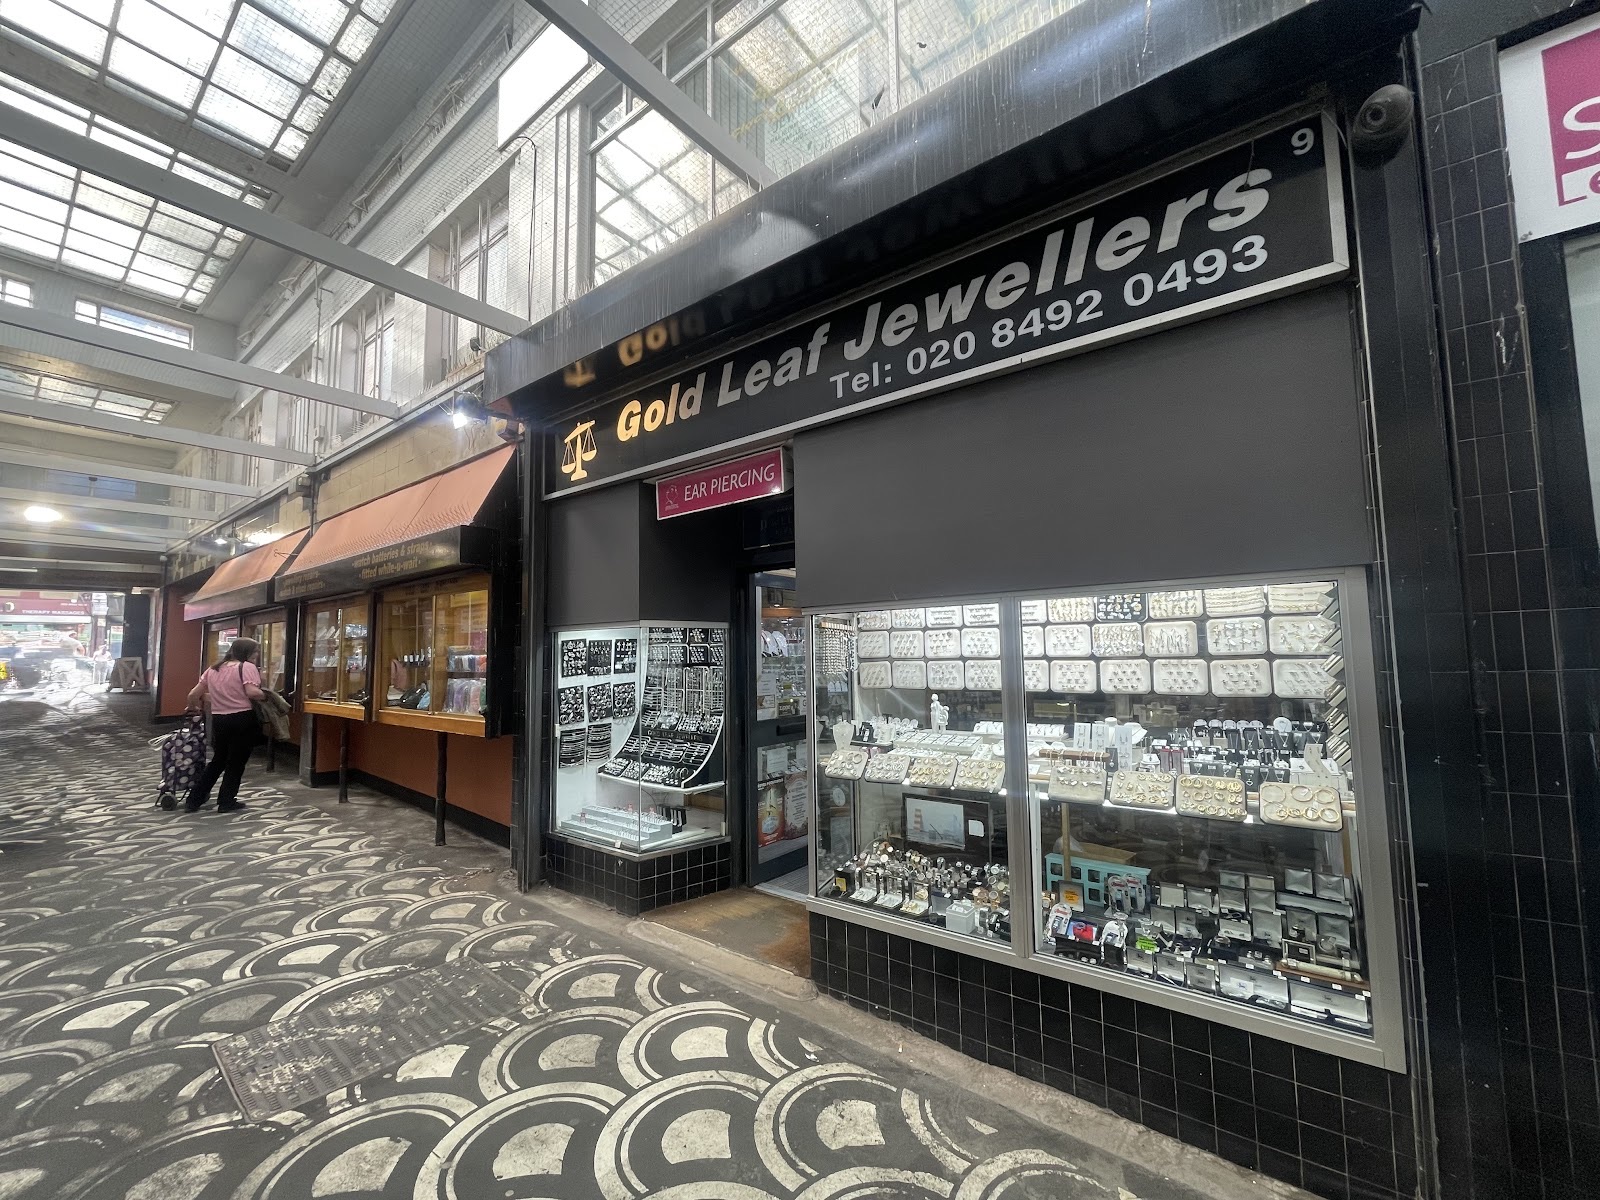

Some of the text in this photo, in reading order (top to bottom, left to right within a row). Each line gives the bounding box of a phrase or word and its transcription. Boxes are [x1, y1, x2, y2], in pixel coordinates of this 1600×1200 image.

[1290, 127, 1315, 156] 9
[617, 168, 1274, 443] Gold Leaf Jewellers
[830, 234, 1269, 400] Tel: 020 8492 0493
[685, 464, 775, 501] EAR PIERCING
[371, 547, 399, 564] batteries
[361, 565, 377, 580] fitted
